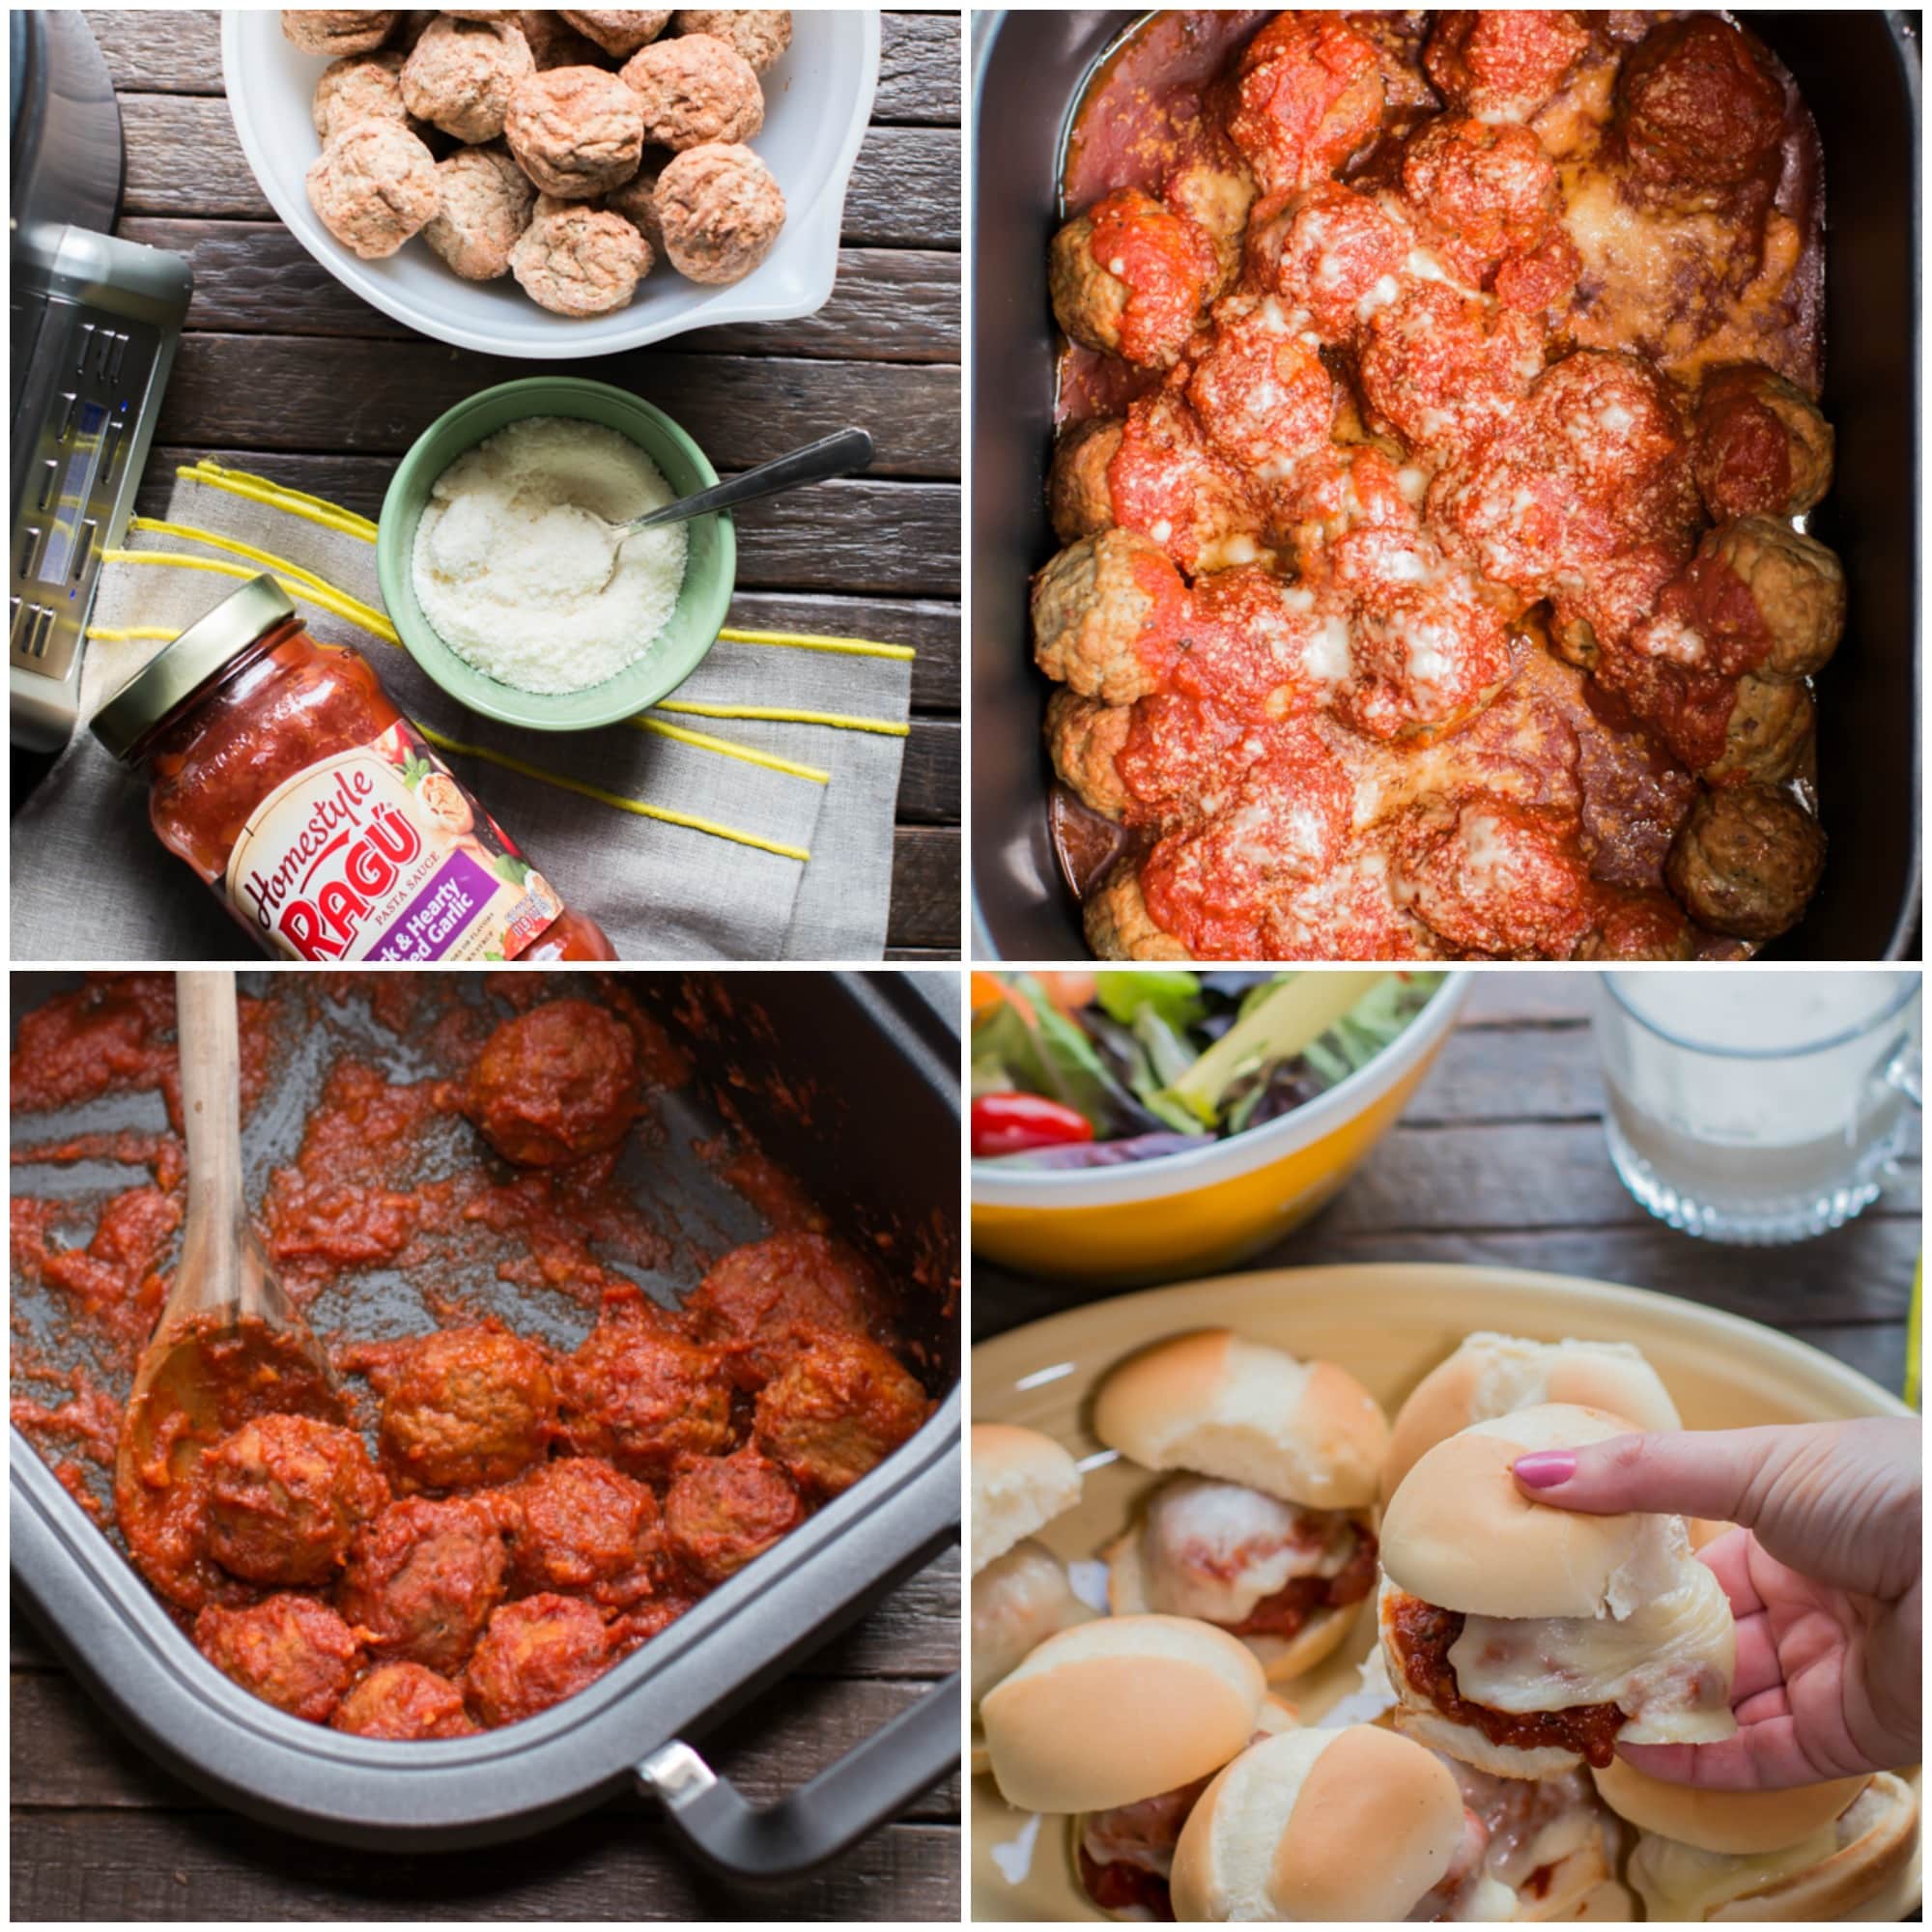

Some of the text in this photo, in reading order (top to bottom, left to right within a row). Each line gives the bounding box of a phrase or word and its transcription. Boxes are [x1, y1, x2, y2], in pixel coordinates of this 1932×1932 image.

[244, 771, 374, 930] Homestyle
[375, 851, 440, 925] PASTA SAUCE
[395, 933, 413, 952] &
[406, 877, 461, 938] Hearty
[427, 893, 474, 943] Garlic
